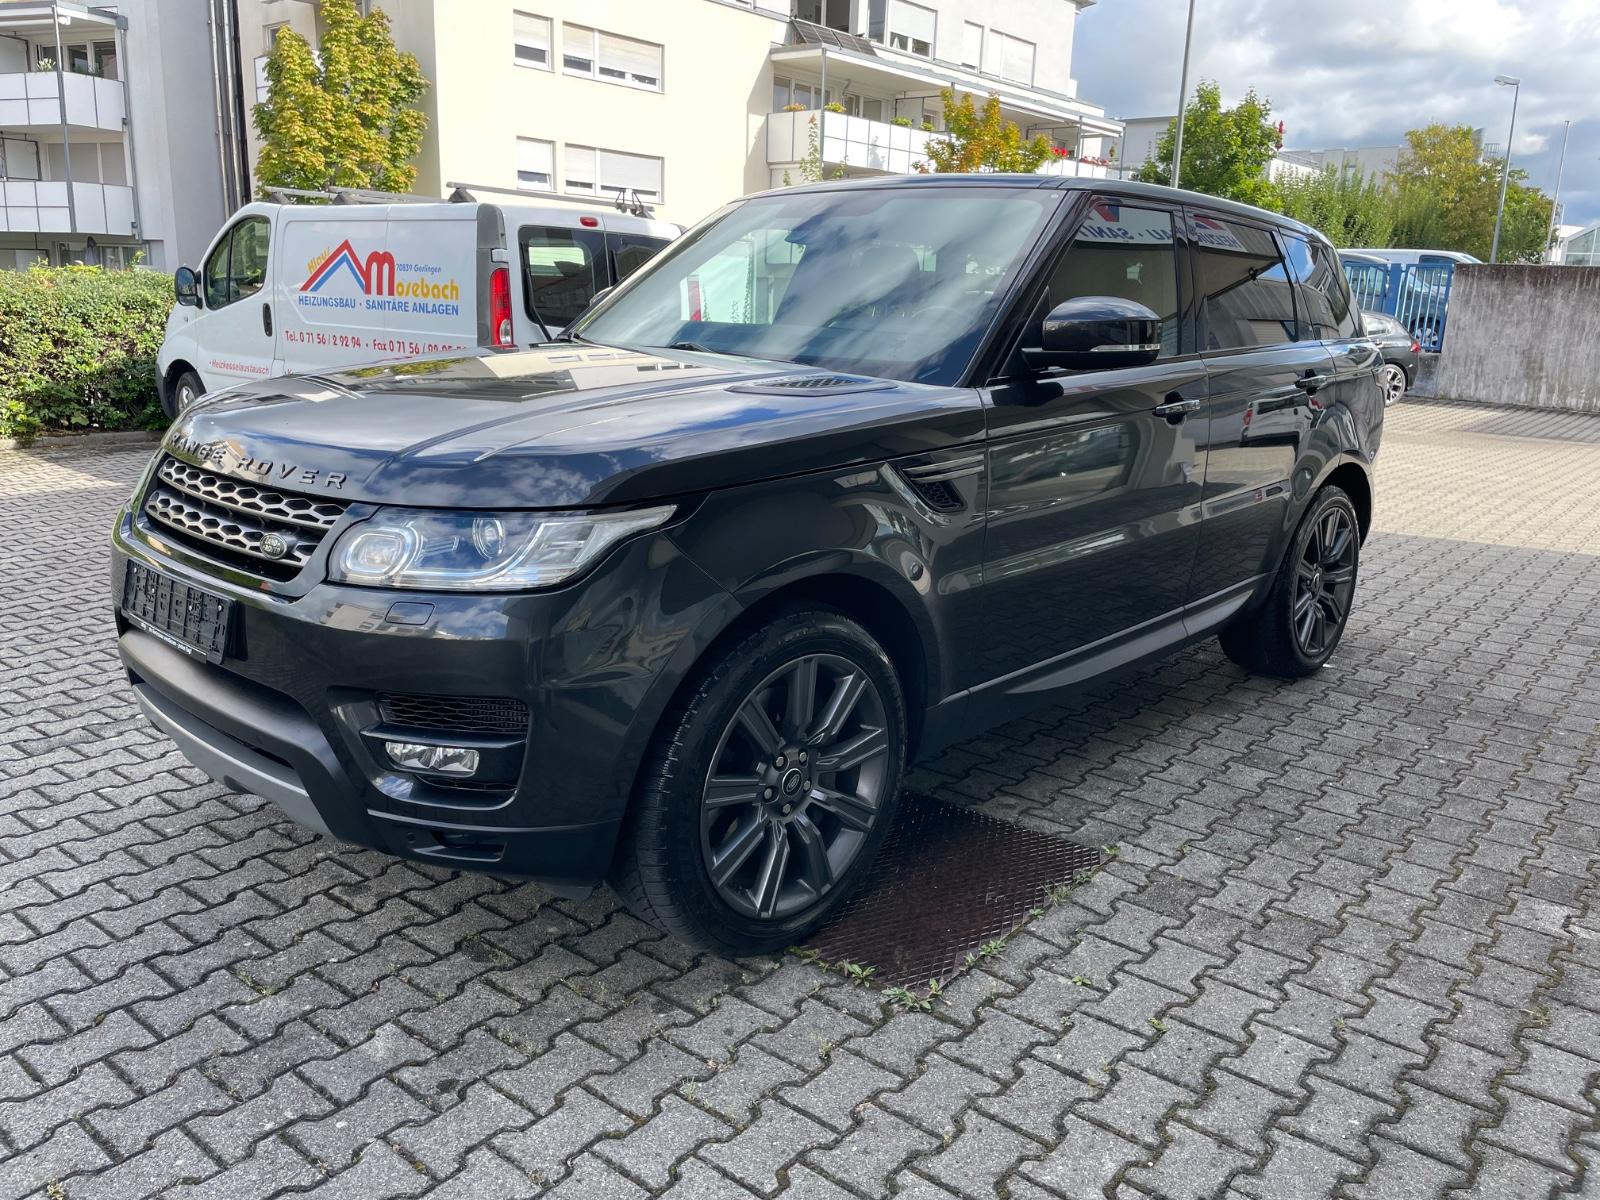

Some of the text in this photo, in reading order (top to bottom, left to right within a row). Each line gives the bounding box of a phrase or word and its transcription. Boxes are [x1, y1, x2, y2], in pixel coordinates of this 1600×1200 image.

[396, 263, 412, 272] 70839
[298, 296, 459, 316] HEIZUNGSBAU SANITÄRE ANLAGEN
[286, 331, 298, 342] Tel.
[306, 333, 314, 343] 71
[317, 333, 326, 344] 56
[332, 335, 337, 346] 2
[340, 336, 349, 347] 92
[351, 336, 361, 348] 94
[373, 339, 387, 351] Fax
[389, 340, 394, 352] 0
[397, 341, 405, 353] 71
[409, 342, 419, 354] 56
[169, 432, 347, 490] RANGE ROVER
